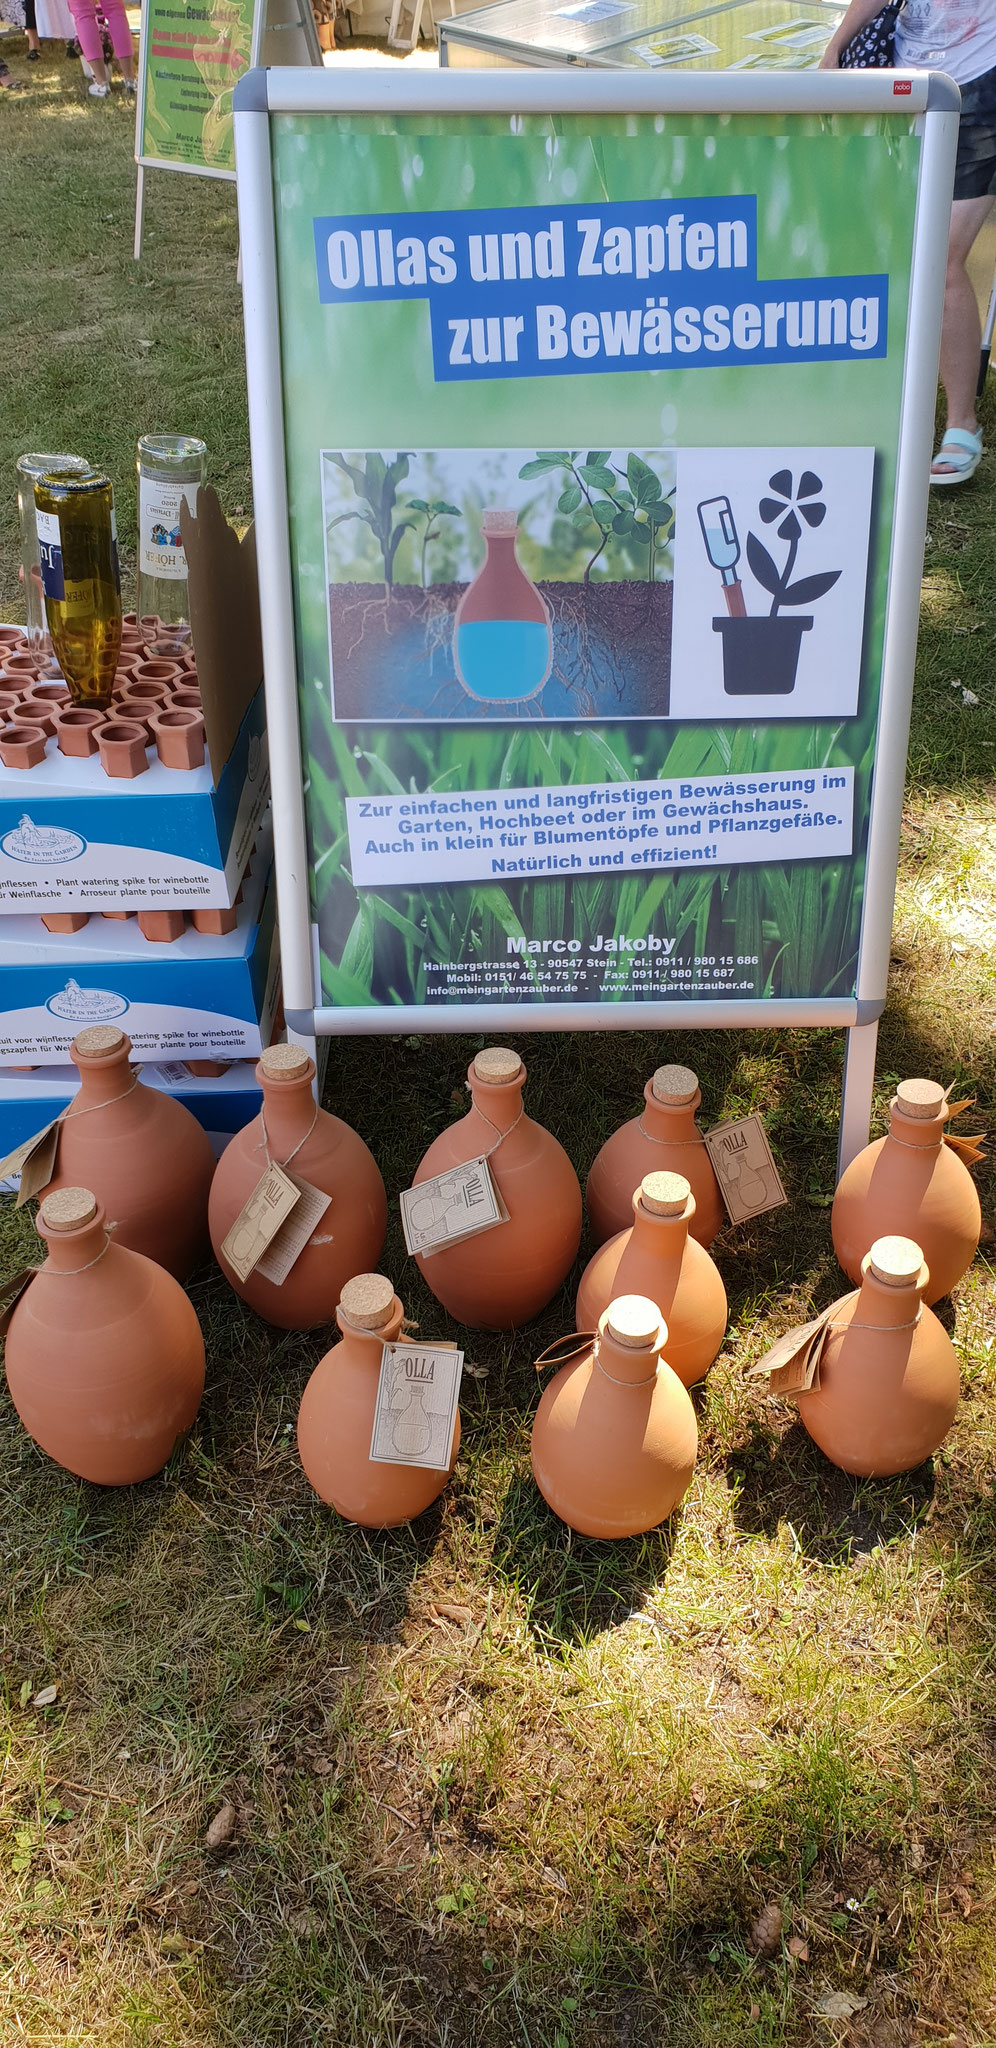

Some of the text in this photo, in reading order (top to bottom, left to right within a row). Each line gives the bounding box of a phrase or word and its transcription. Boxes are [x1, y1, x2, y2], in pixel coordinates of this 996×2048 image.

[327, 213, 747, 290] Ollas und Zapfen
[448, 297, 879, 365] zur Bewässerung
[359, 775, 846, 818] Zur einfachen und langfristigen Bewässerung im
[398, 798, 808, 834] Garten, Hochbeet oder im Gewächshaus.
[365, 812, 843, 855] Auch in klein für Blumentöpfe und Pflanzgefäße.
[11, 845, 31, 856] WATER
[54, 845, 78, 856] GARDEN
[491, 844, 717, 872] Natürlich und effizient!
[56, 878, 79, 887] Plant
[81, 877, 120, 886] watering
[122, 877, 145, 886] spike
[163, 876, 209, 884] winebottle
[9, 890, 61, 898] Weinflasche
[120, 888, 147, 897] plante
[150, 888, 170, 896] pour
[173, 887, 211, 895] bouteille
[507, 934, 676, 955] Marco Jakoby
[423, 960, 520, 971] Hainbergstrasse
[523, 960, 537, 969] 13
[547, 959, 583, 968] 90547
[586, 958, 617, 968] Stein
[628, 958, 652, 967] Tel.:
[656, 957, 683, 966] 0911
[694, 956, 716, 965] 980
[719, 956, 734, 965] 15
[736, 956, 759, 965] 686
[446, 973, 481, 983] Mobil:
[485, 972, 516, 981] 0151/
[519, 972, 534, 981] 46
[537, 971, 552, 980] 54
[555, 971, 569, 980] 75
[572, 971, 587, 980] 75
[604, 970, 629, 979] Fax:
[632, 970, 659, 979] 0911
[670, 969, 692, 978] 980
[696, 969, 710, 977] 15
[713, 968, 735, 977] 687
[427, 983, 579, 996] info@meingartenzauber.de
[599, 980, 755, 992] www.meingartenzauber.de
[57, 1005, 77, 1015] WATER
[99, 1005, 121, 1014] GARDEN
[162, 1031, 184, 1039] spike
[202, 1029, 245, 1037] winebottle
[40, 1044, 52, 1052] für
[160, 1041, 186, 1049] plante
[189, 1040, 208, 1048] pour
[211, 1039, 246, 1047] bouteille
[723, 1130, 748, 1152] OLLA
[266, 1180, 284, 1206] OLLA
[466, 1178, 485, 1207] OLLA
[405, 1357, 435, 1380] OLLA
